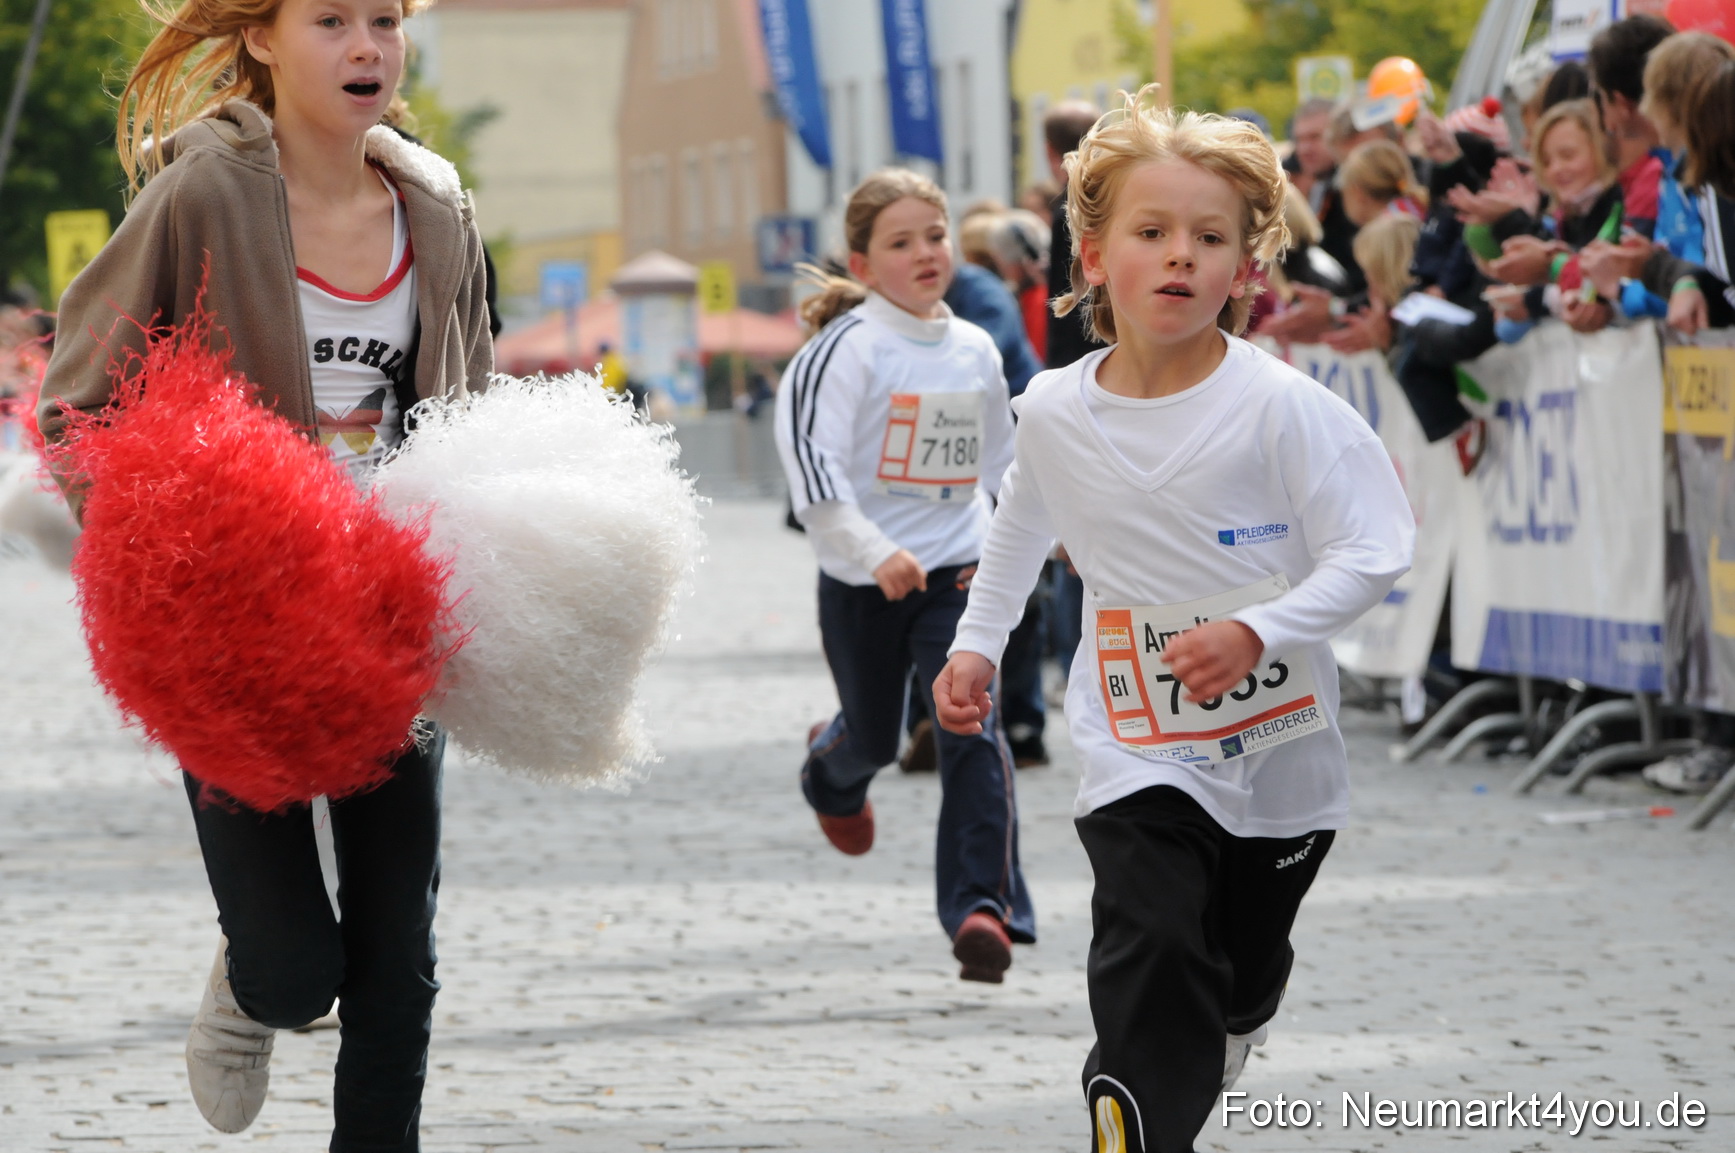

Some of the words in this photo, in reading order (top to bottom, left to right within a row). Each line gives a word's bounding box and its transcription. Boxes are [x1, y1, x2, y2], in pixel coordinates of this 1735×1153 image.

[921, 436, 978, 466] 7180
[1236, 523, 1289, 540] PFLEIDERER
[1109, 674, 1129, 697] B1
[1243, 706, 1320, 744] PFLEIDERER
[1247, 719, 1323, 752] AKTIENGESELLSCHAFT
